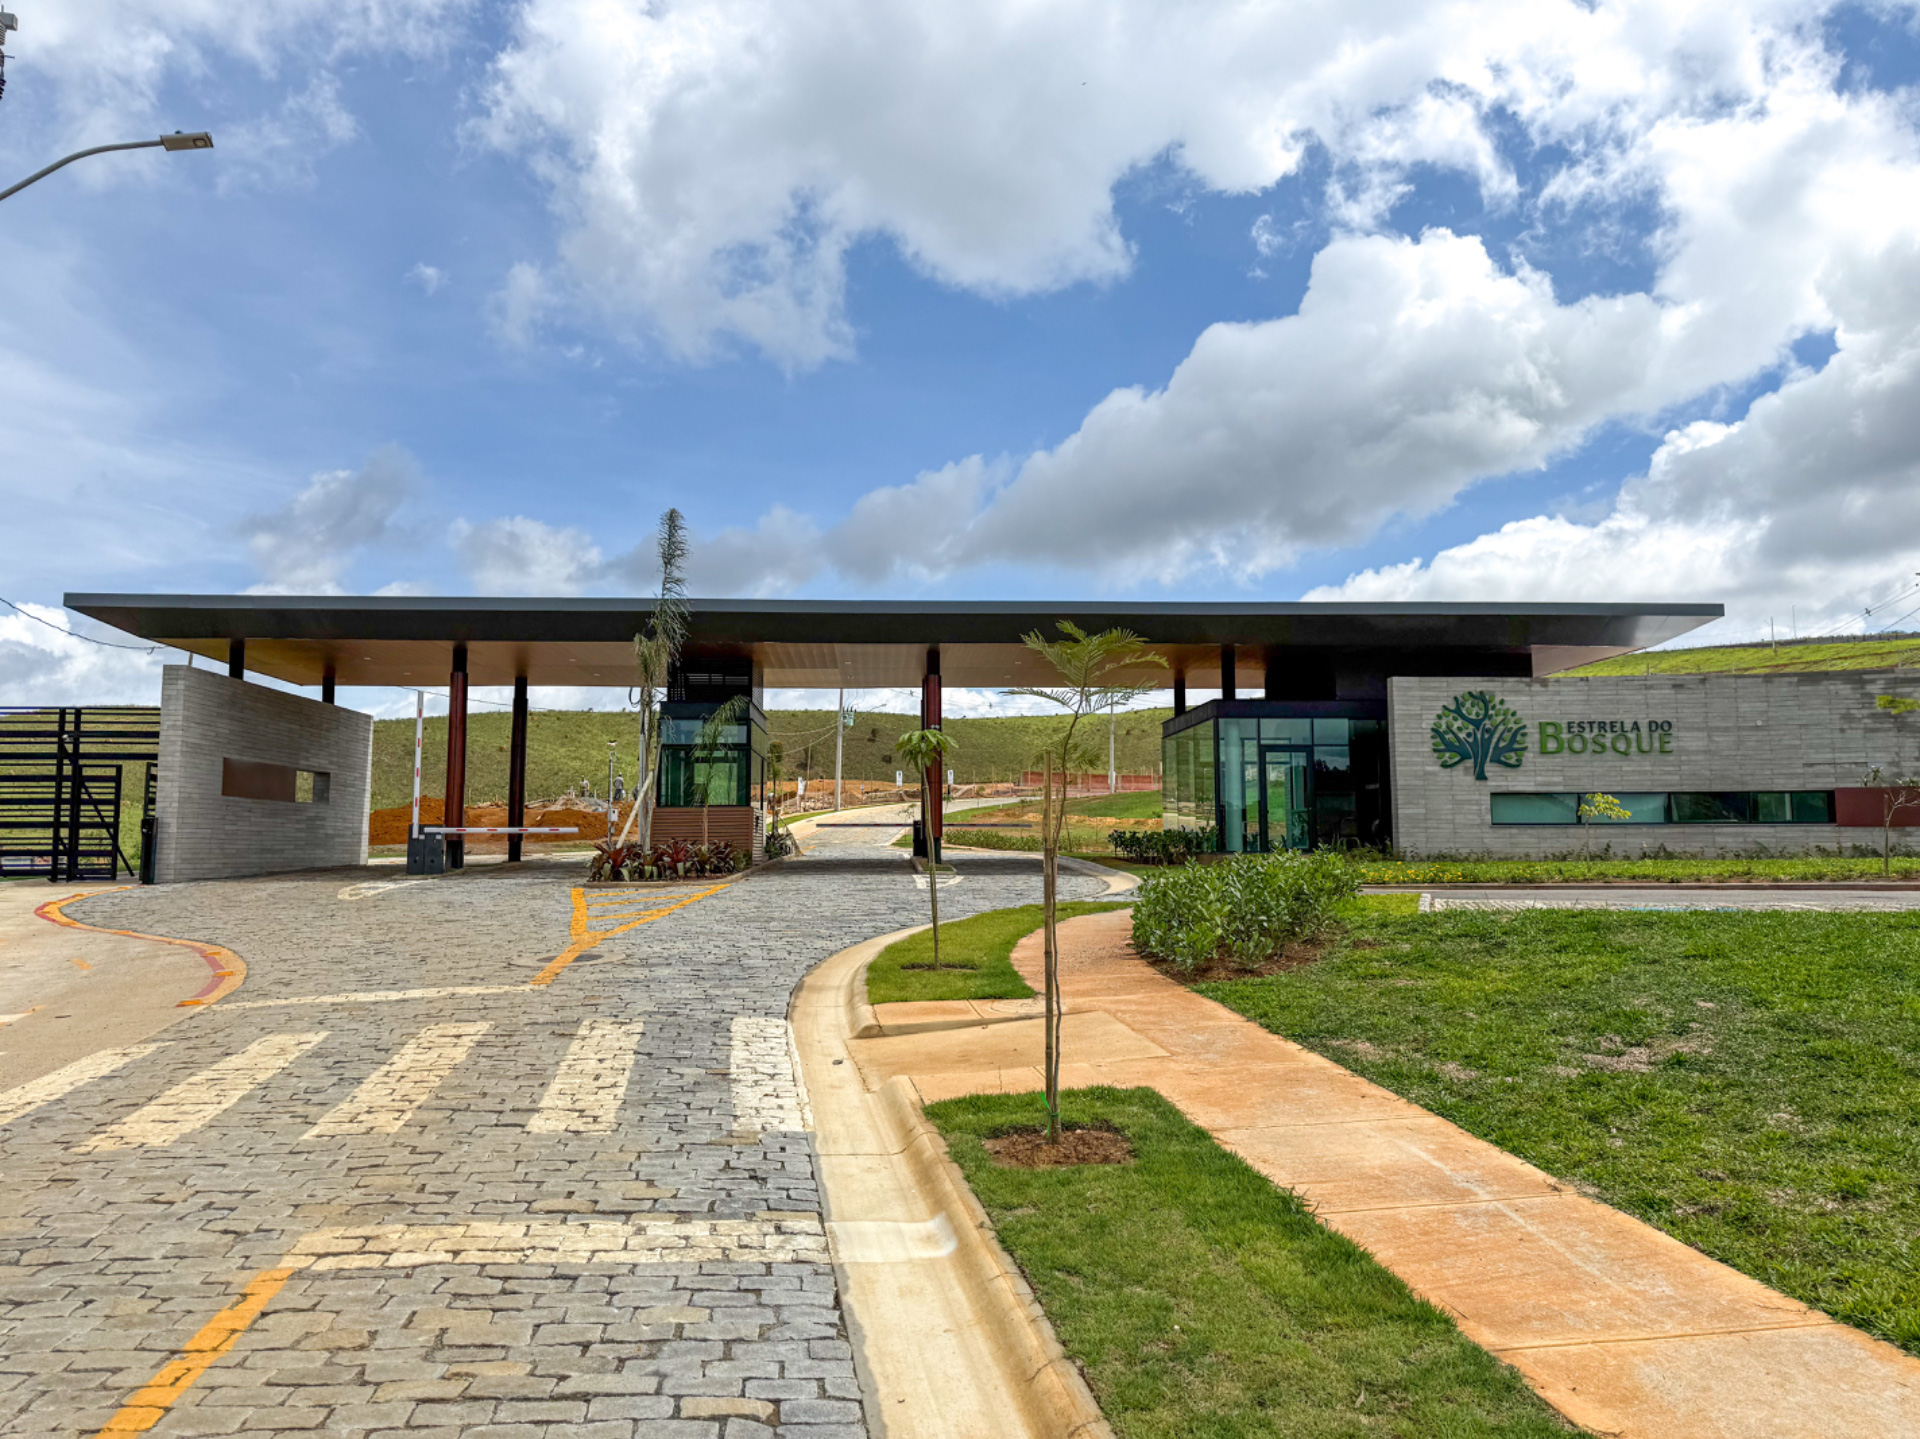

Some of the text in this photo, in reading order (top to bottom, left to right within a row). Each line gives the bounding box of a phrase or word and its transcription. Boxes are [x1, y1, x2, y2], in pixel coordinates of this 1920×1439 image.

[1538, 721, 1674, 756] BOSQUE
[1567, 720, 1673, 734] ESTRELA DO
